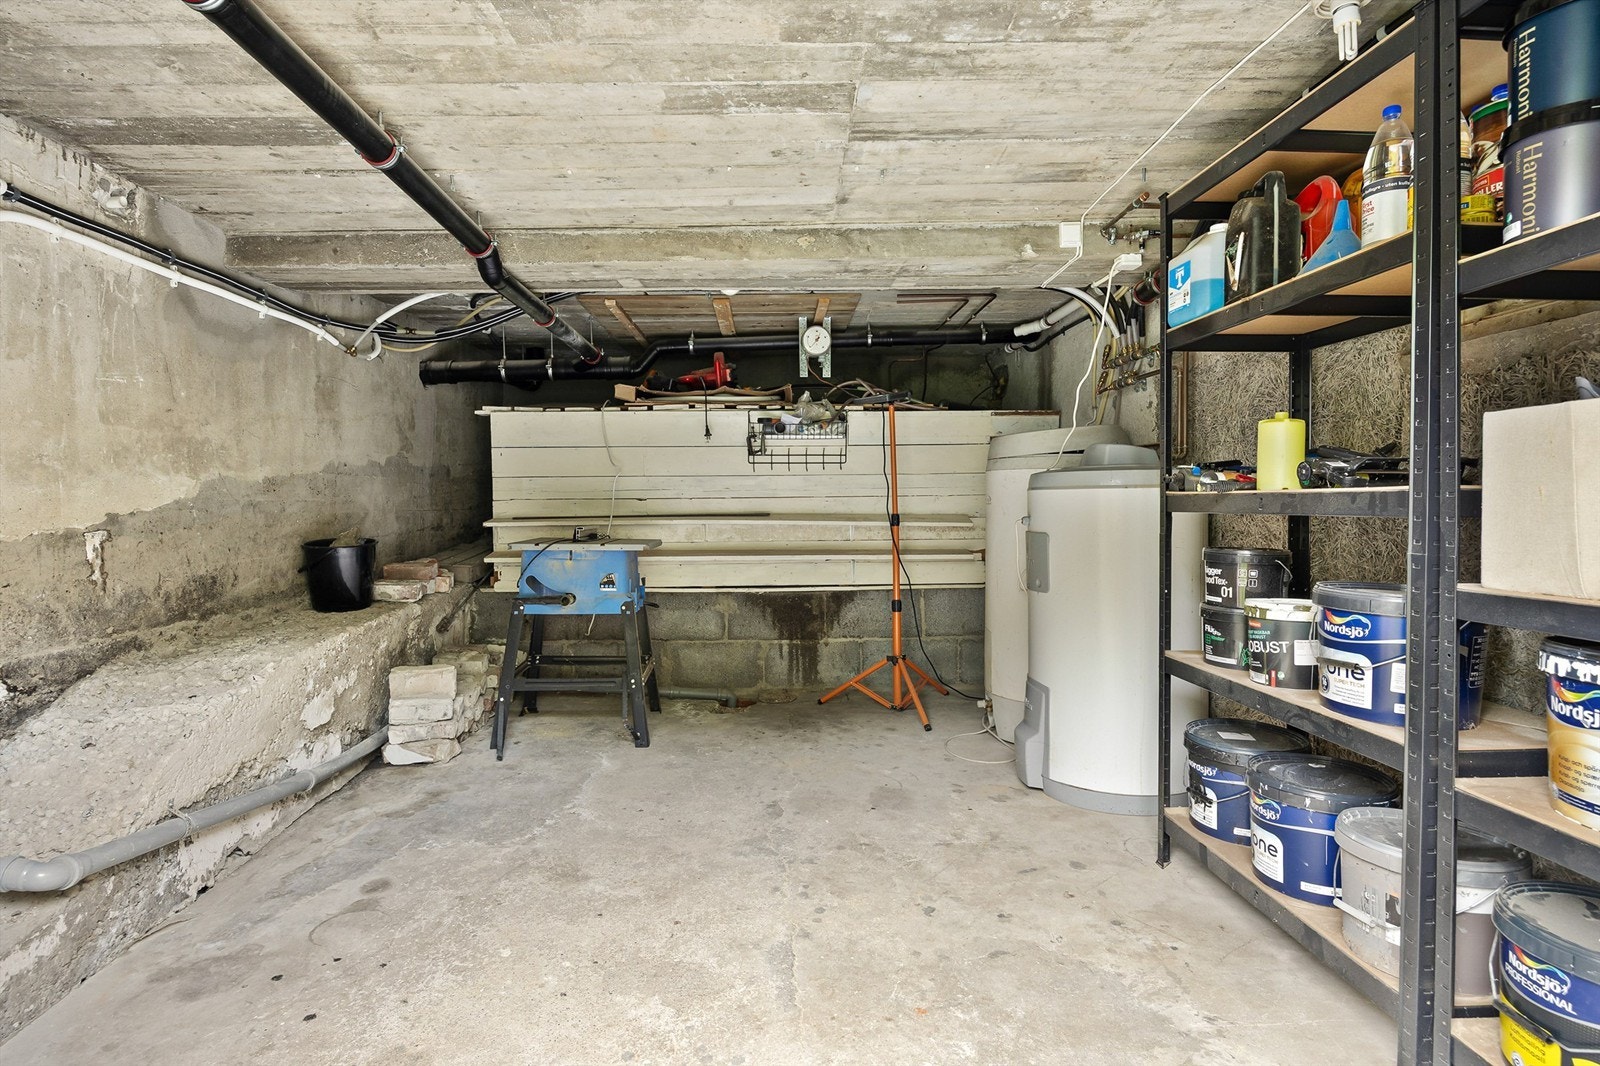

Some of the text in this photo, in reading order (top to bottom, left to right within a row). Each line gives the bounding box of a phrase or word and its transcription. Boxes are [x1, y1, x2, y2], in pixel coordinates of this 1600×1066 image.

[1518, 26, 1536, 121] Harmoni
[1522, 141, 1543, 235] Harmoni
[1220, 586, 1233, 599] 01
[1324, 620, 1364, 639] Nordsjö
[1248, 640, 1290, 654] OBUST
[1550, 694, 1600, 729] Nordsj
[1251, 802, 1276, 820] ordsjö
[1252, 833, 1278, 858] one
[1508, 949, 1562, 994] Nordsjö
[1504, 961, 1578, 1016] PROFESSIONAL
